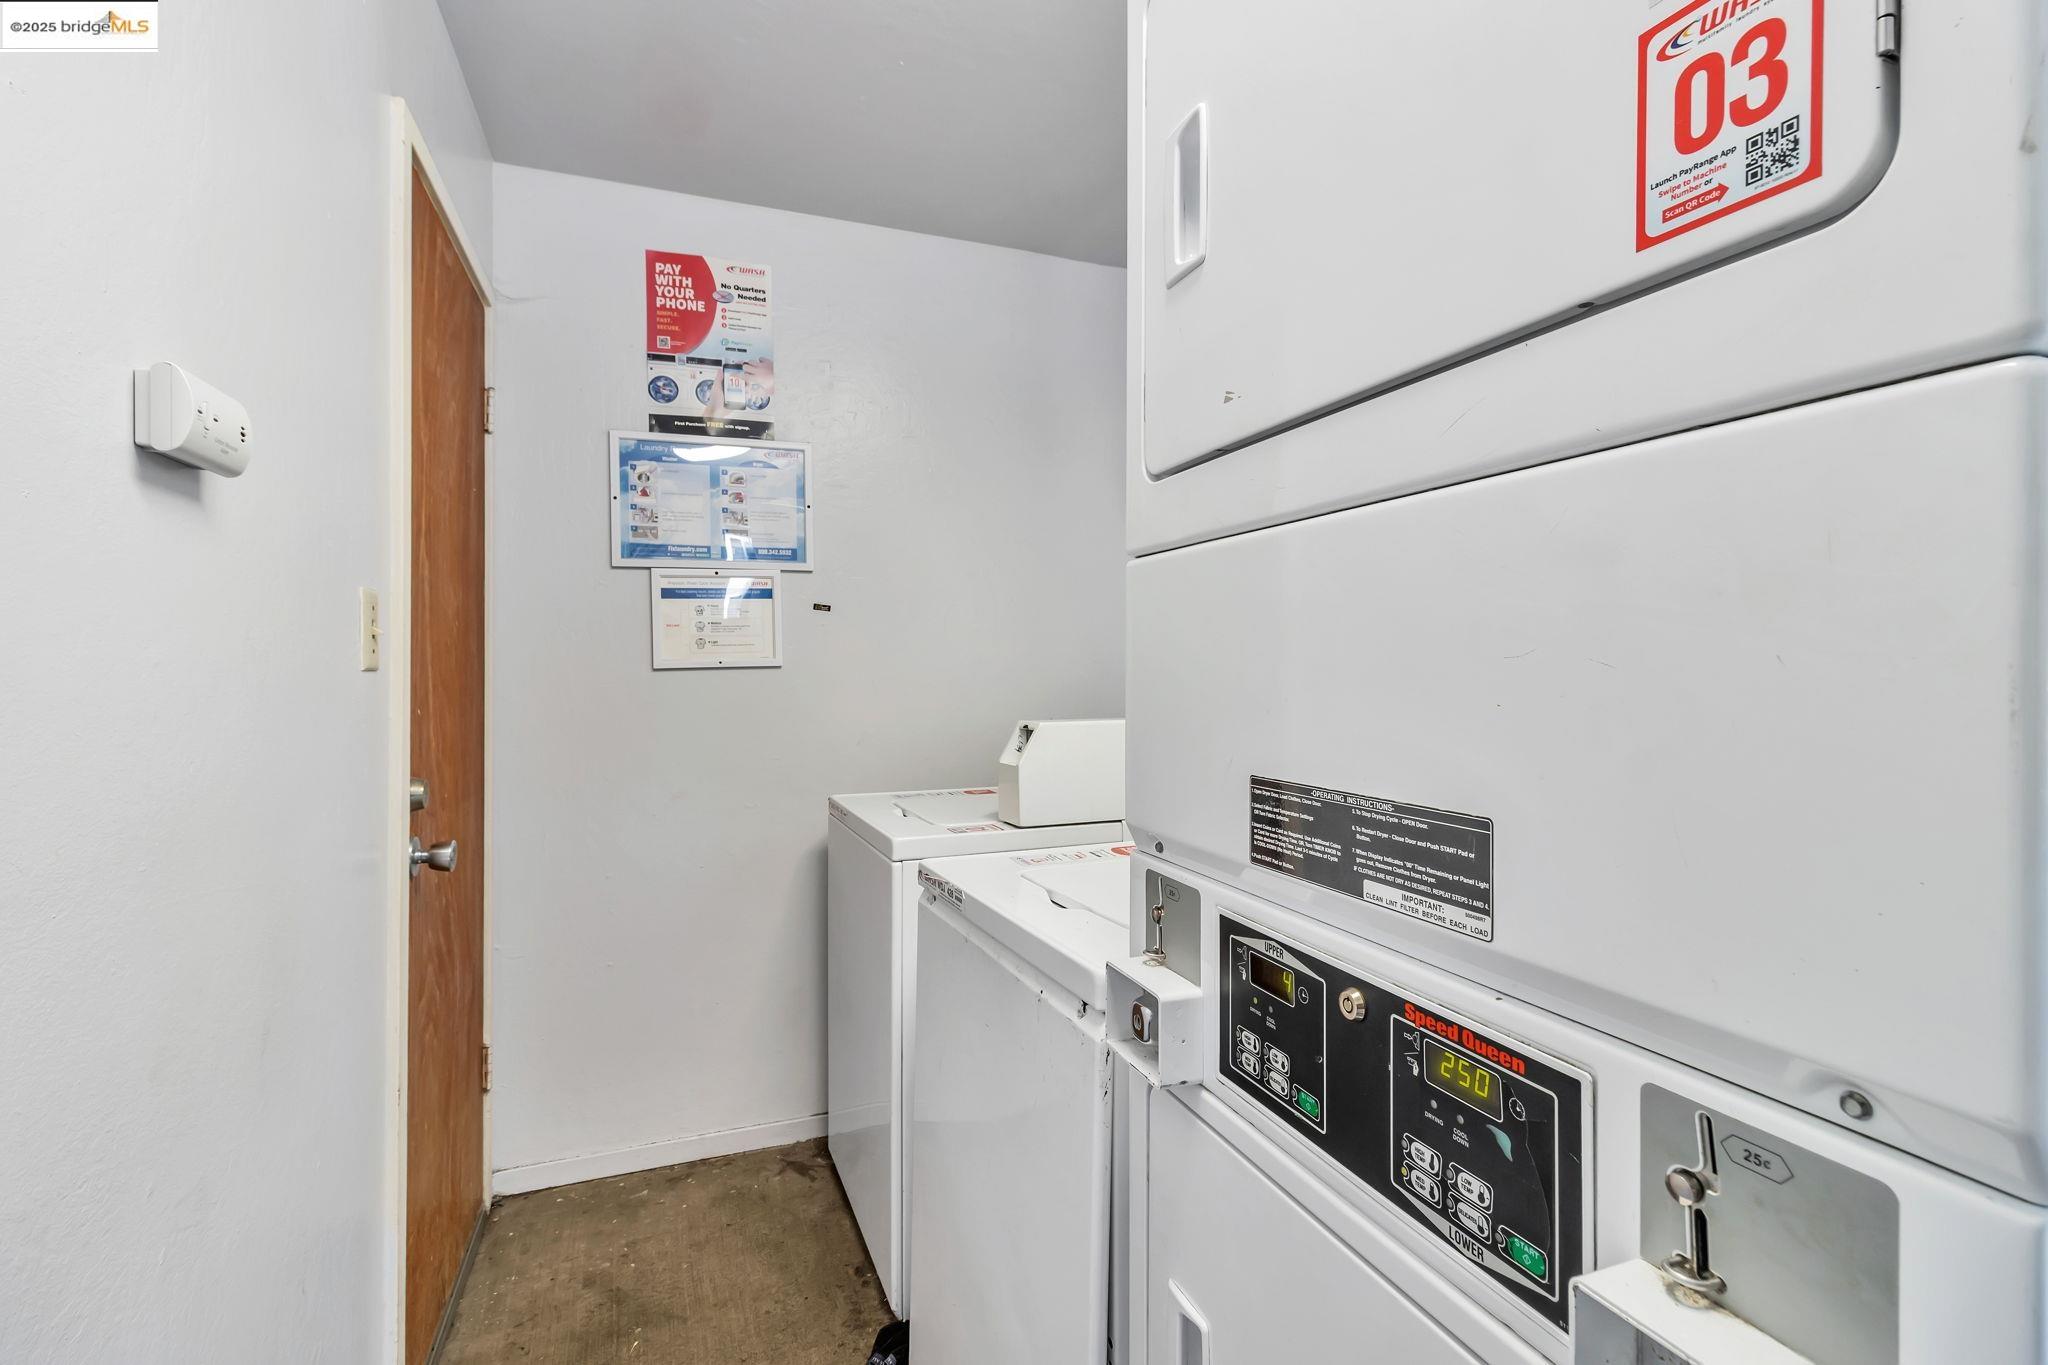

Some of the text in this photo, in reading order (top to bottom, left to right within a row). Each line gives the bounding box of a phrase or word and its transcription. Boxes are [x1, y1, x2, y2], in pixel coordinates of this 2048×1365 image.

[1674, 17, 1789, 156] 03
[1650, 144, 1736, 190] Launch PayRange App
[1658, 160, 1727, 199] Swipe to Machine
[1670, 176, 1712, 202] Number or
[1664, 187, 1720, 220] Scan QR Code
[655, 262, 682, 275] PAY
[655, 273, 692, 288] WITH
[734, 284, 766, 294] Quarters
[655, 284, 695, 300] YOUR
[738, 294, 766, 302] Needed
[656, 296, 706, 312] PHONE
[1371, 812, 1385, 821] Drying
[1386, 815, 1398, 823] Cycle
[1401, 818, 1415, 826] OPEN
[1361, 827, 1376, 835] Restart
[1376, 830, 1388, 839] Dryer
[1391, 833, 1404, 842] Close
[1404, 836, 1416, 845] Door
[1426, 841, 1439, 850] Push
[1440, 844, 1456, 854] START
[1457, 848, 1467, 856] Pad
[1355, 848, 1367, 856] When
[1367, 851, 1382, 861] Display
[1414, 863, 1425, 872] Time
[1426, 866, 1452, 880] Remaining
[1459, 874, 1474, 884] Panel
[1475, 879, 1489, 890] Light
[1392, 866, 1409, 876] Clothes
[1410, 871, 1421, 879] from
[1357, 866, 1376, 877] CLOTHES
[1432, 887, 1450, 898] REPEAT
[1451, 892, 1467, 903] STEPS
[1472, 898, 1484, 907] AND
[1401, 893, 1444, 913] IMPORTANT:
[1365, 891, 1382, 903] CLEAN
[1385, 898, 1397, 908] LINT
[1400, 902, 1418, 915] FILTER
[1422, 909, 1446, 924] BEFORE
[1449, 918, 1467, 931] EACH
[1470, 925, 1488, 938] LOAD
[1264, 941, 1284, 960] UPPER
[1283, 971, 1292, 993] 4
[1404, 1002, 1526, 1075] Speed Queen
[1440, 1052, 1490, 1098] 250
[1424, 1110, 1443, 1127] DRYING
[1452, 1133, 1468, 1148] DOWN
[1453, 1126, 1468, 1141] COOL
[1414, 1152, 1425, 1164] TEMP
[1415, 1179, 1425, 1192] TEMP
[1460, 1175, 1471, 1188] LOW
[1460, 1182, 1473, 1196] TEMP
[1449, 1224, 1484, 1263] LOWER
[1514, 1237, 1538, 1261] START
